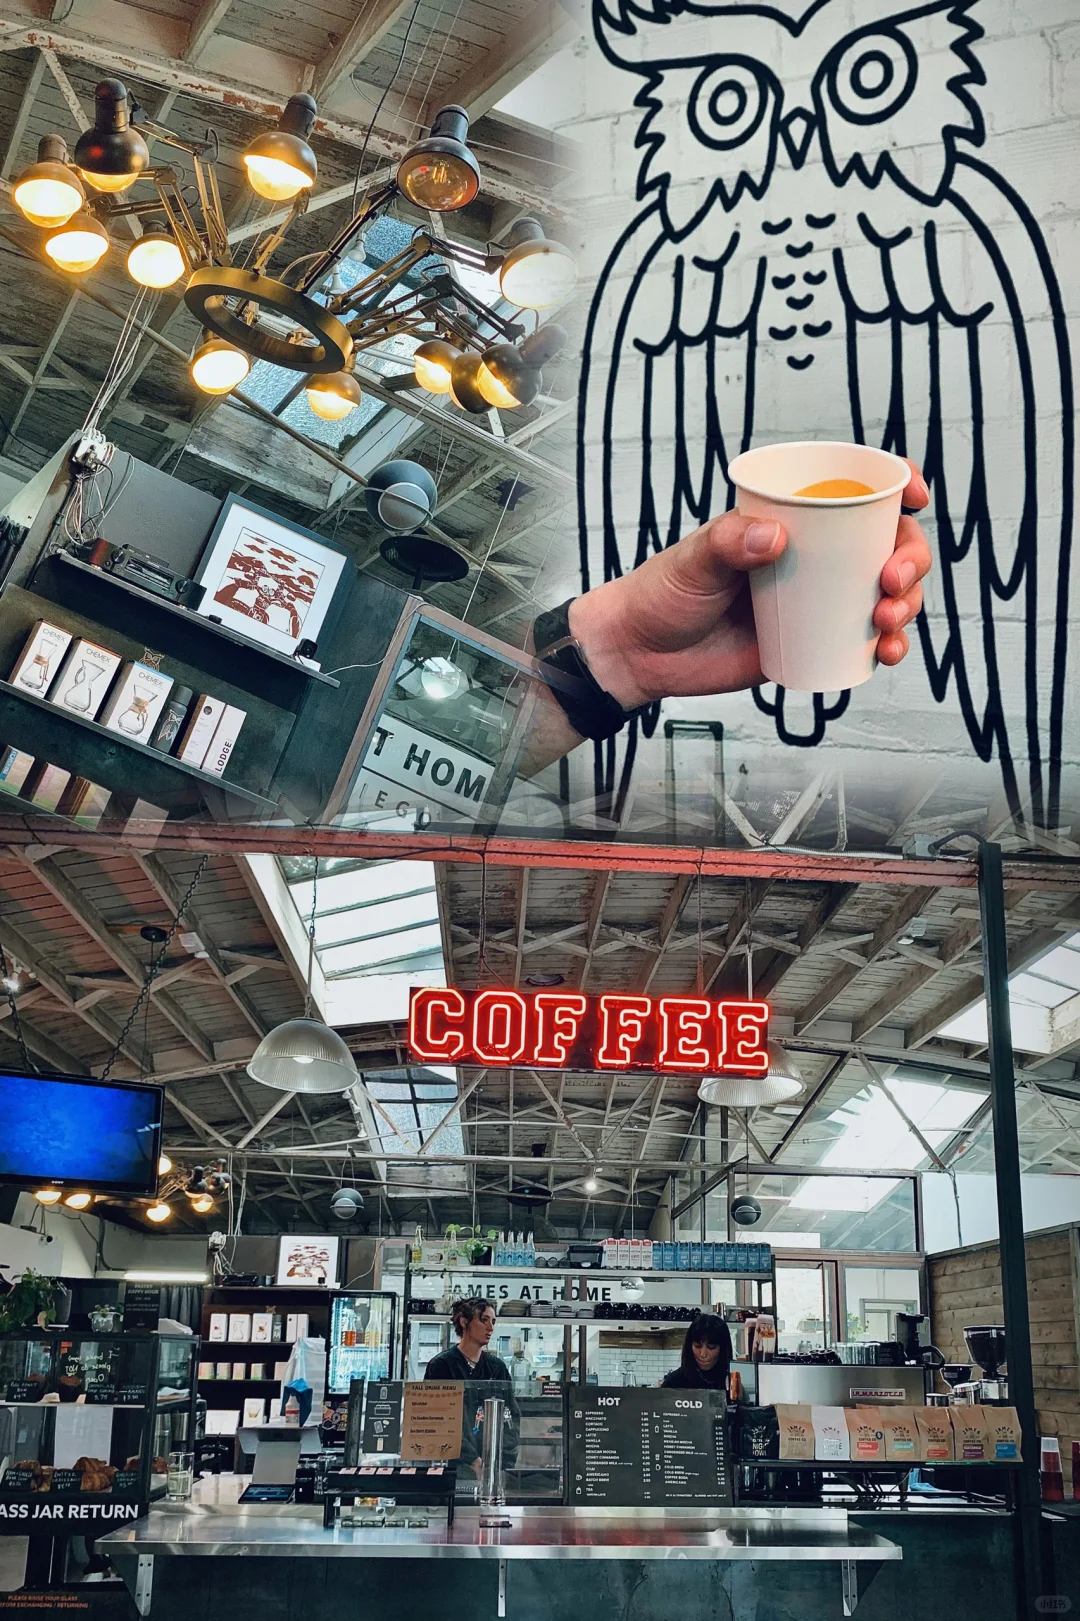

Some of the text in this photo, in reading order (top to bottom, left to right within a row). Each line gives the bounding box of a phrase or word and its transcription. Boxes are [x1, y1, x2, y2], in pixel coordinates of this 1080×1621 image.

[42, 628, 66, 643] CHEMEX
[85, 647, 111, 663] CHEMEX
[138, 671, 164, 687] CHEMEX
[214, 741, 233, 772] LODGE
[403, 743, 487, 803] HOM
[409, 987, 770, 1071] COFFEE
[519, 1285, 543, 1300] AT
[553, 1286, 611, 1301] HOME
[597, 1397, 621, 1406] HOT
[675, 1400, 703, 1409] COLD
[0, 1503, 139, 1519] ASS JAR RETURN
